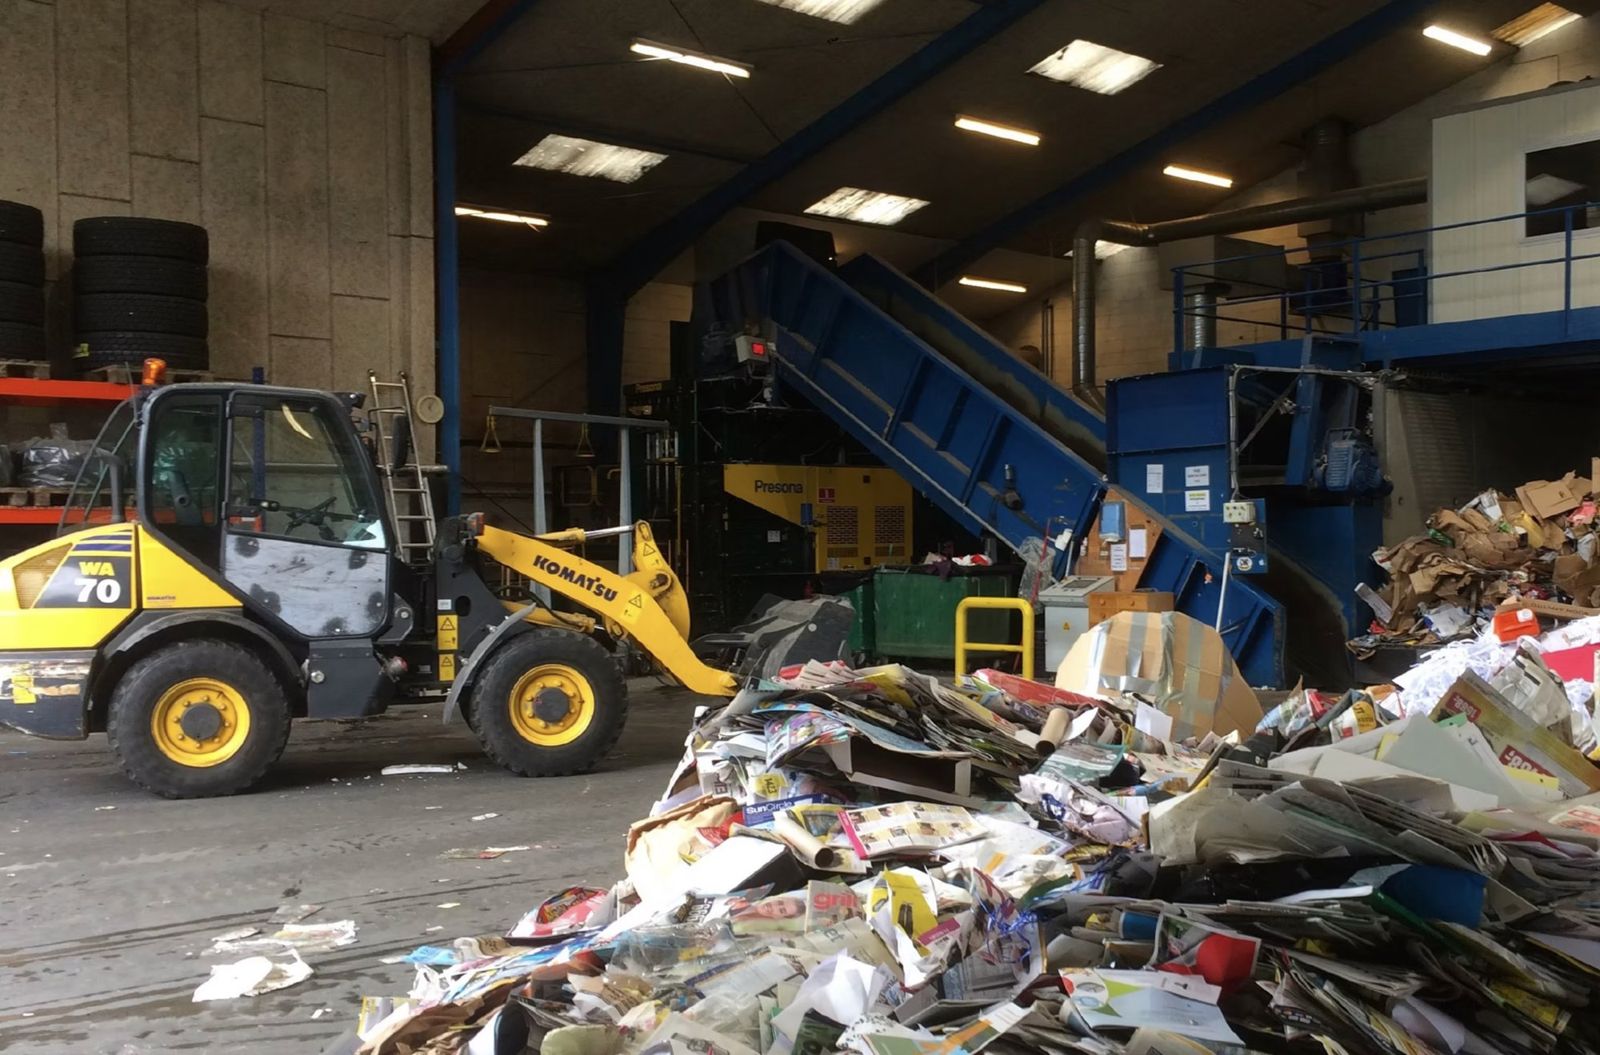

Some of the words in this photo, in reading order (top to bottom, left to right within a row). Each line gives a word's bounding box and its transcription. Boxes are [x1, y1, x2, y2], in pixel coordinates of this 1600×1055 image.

[754, 480, 804, 494] Presona
[79, 562, 115, 577] WA
[533, 555, 618, 602] KOMATSU
[75, 578, 121, 604] 70
[746, 800, 793, 815] SunCircle
